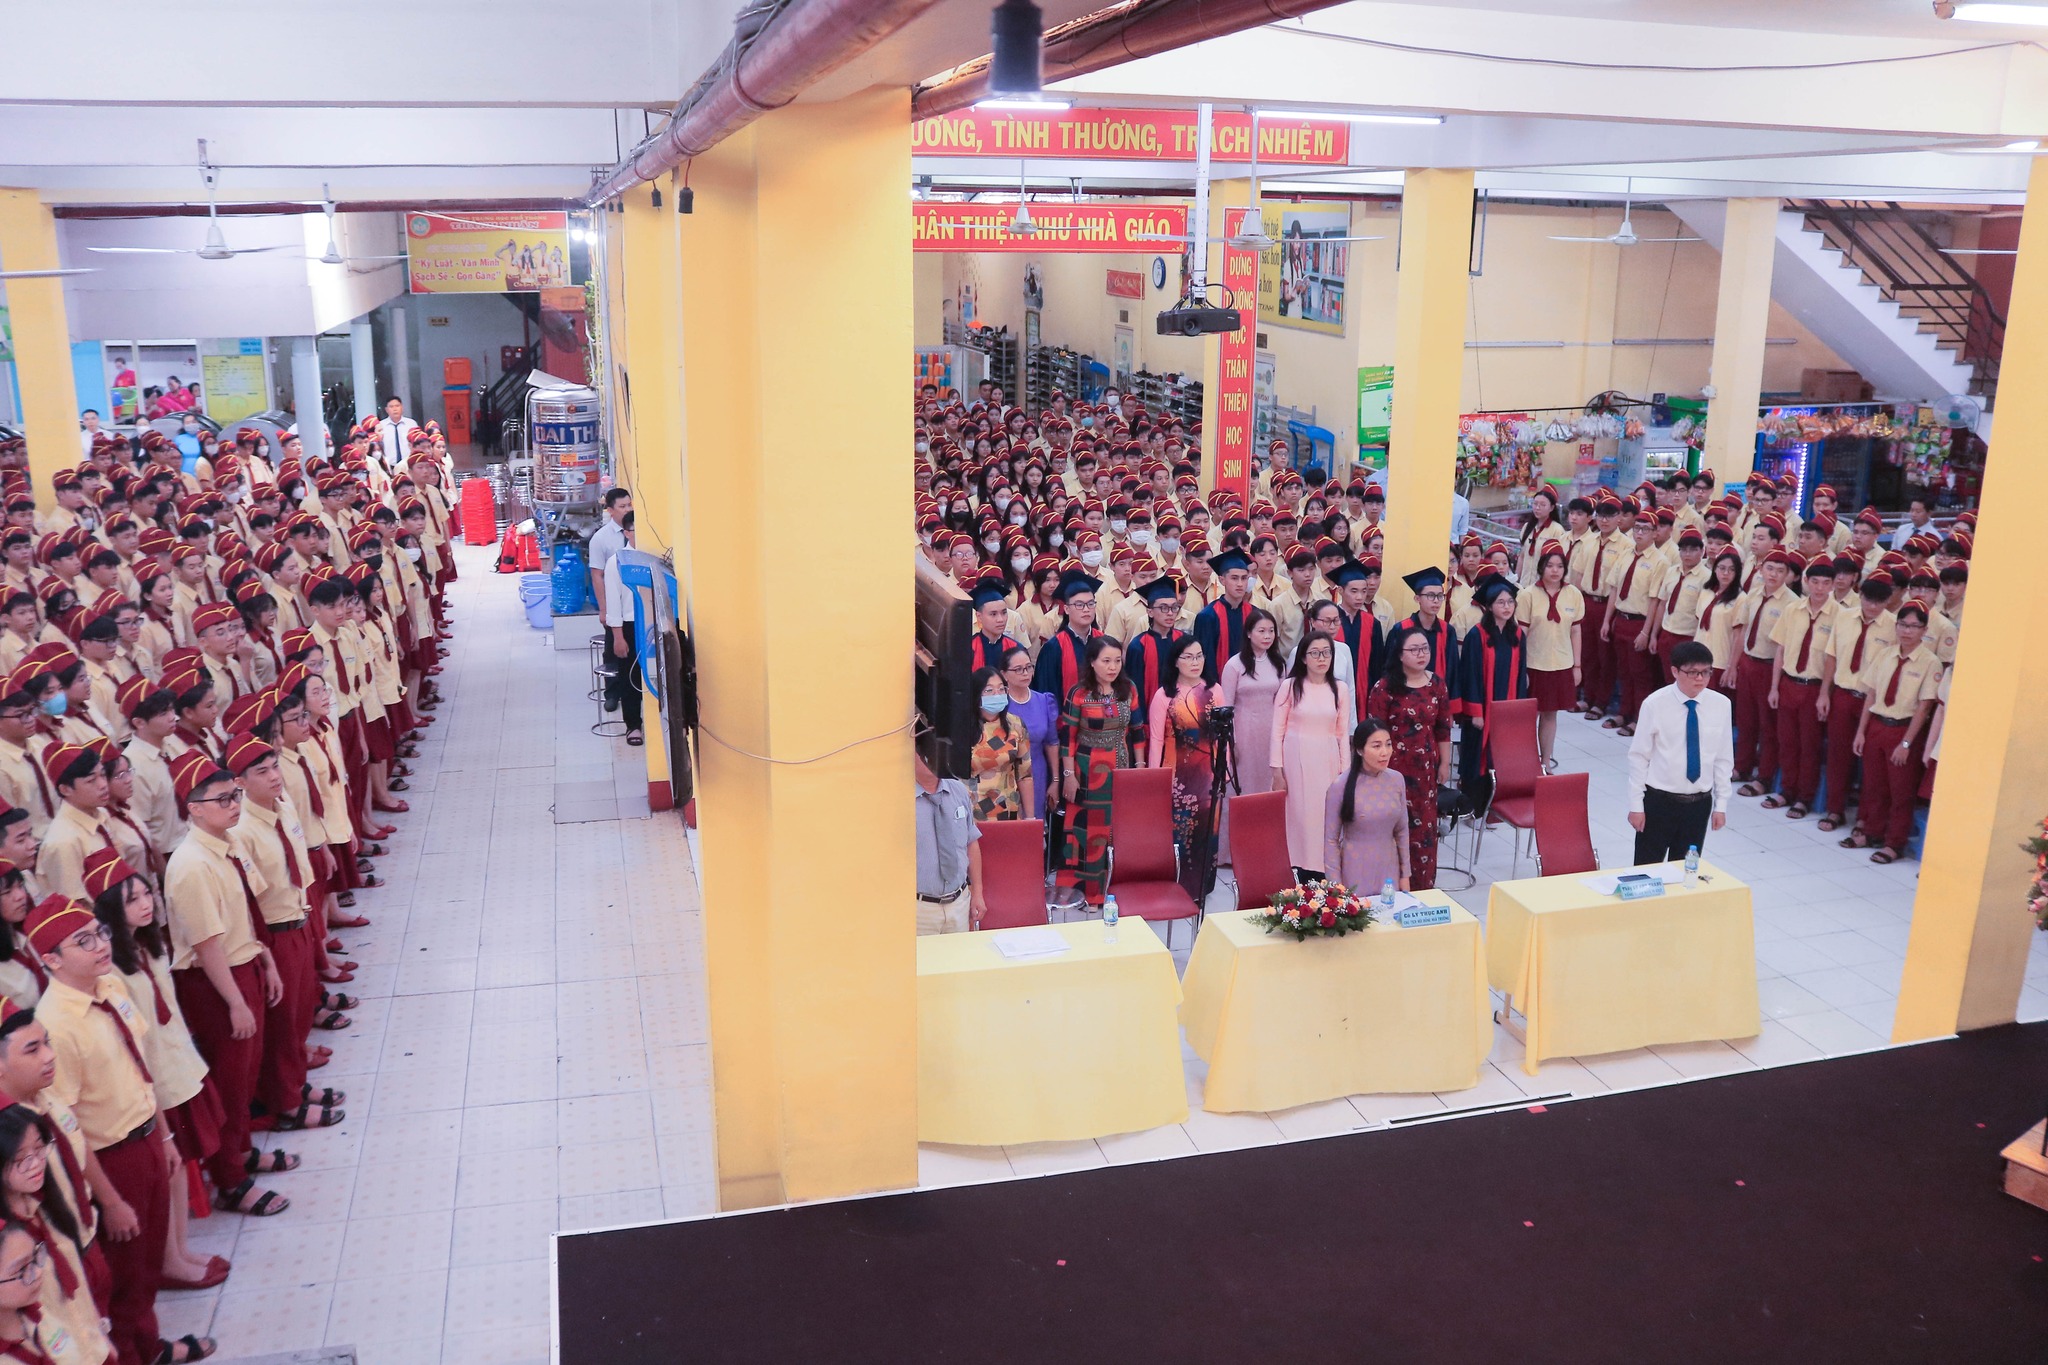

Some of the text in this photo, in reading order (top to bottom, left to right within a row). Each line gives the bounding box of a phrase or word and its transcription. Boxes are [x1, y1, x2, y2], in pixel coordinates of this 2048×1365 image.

[992, 113, 1050, 149] TÌNH
[1058, 117, 1163, 157] THƯƠNG,
[1259, 121, 1334, 161] NHIỆM
[1078, 211, 1118, 241] NHÀ
[1125, 212, 1171, 243] GIÁO
[1229, 253, 1252, 280] DỰNG
[1226, 354, 1248, 378] THÂN
[1223, 388, 1248, 415] THIỆN
[1225, 426, 1243, 449] HỌC
[1223, 459, 1242, 479] SINH
